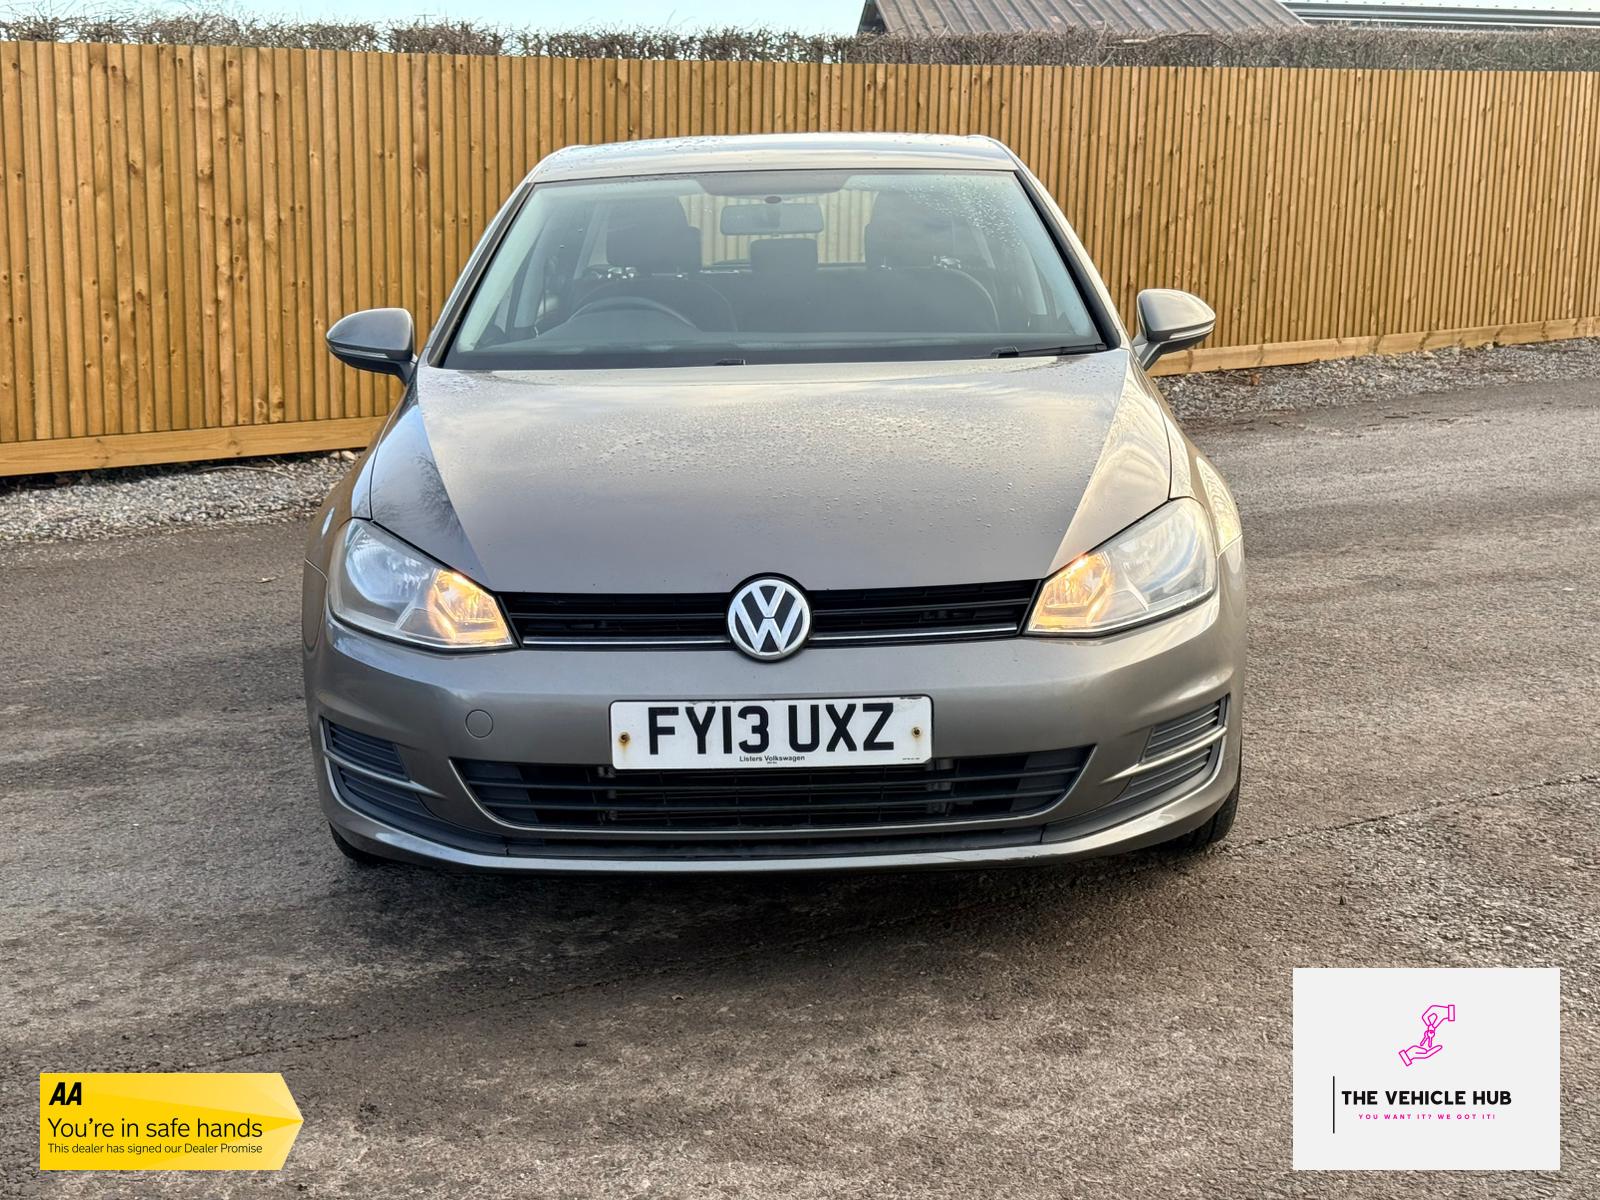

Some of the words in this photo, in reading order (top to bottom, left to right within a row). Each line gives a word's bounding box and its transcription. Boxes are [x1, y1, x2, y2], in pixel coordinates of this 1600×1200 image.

[648, 705, 770, 755] FY13
[788, 703, 894, 753] UXZ
[764, 755, 806, 763] Volkswagen
